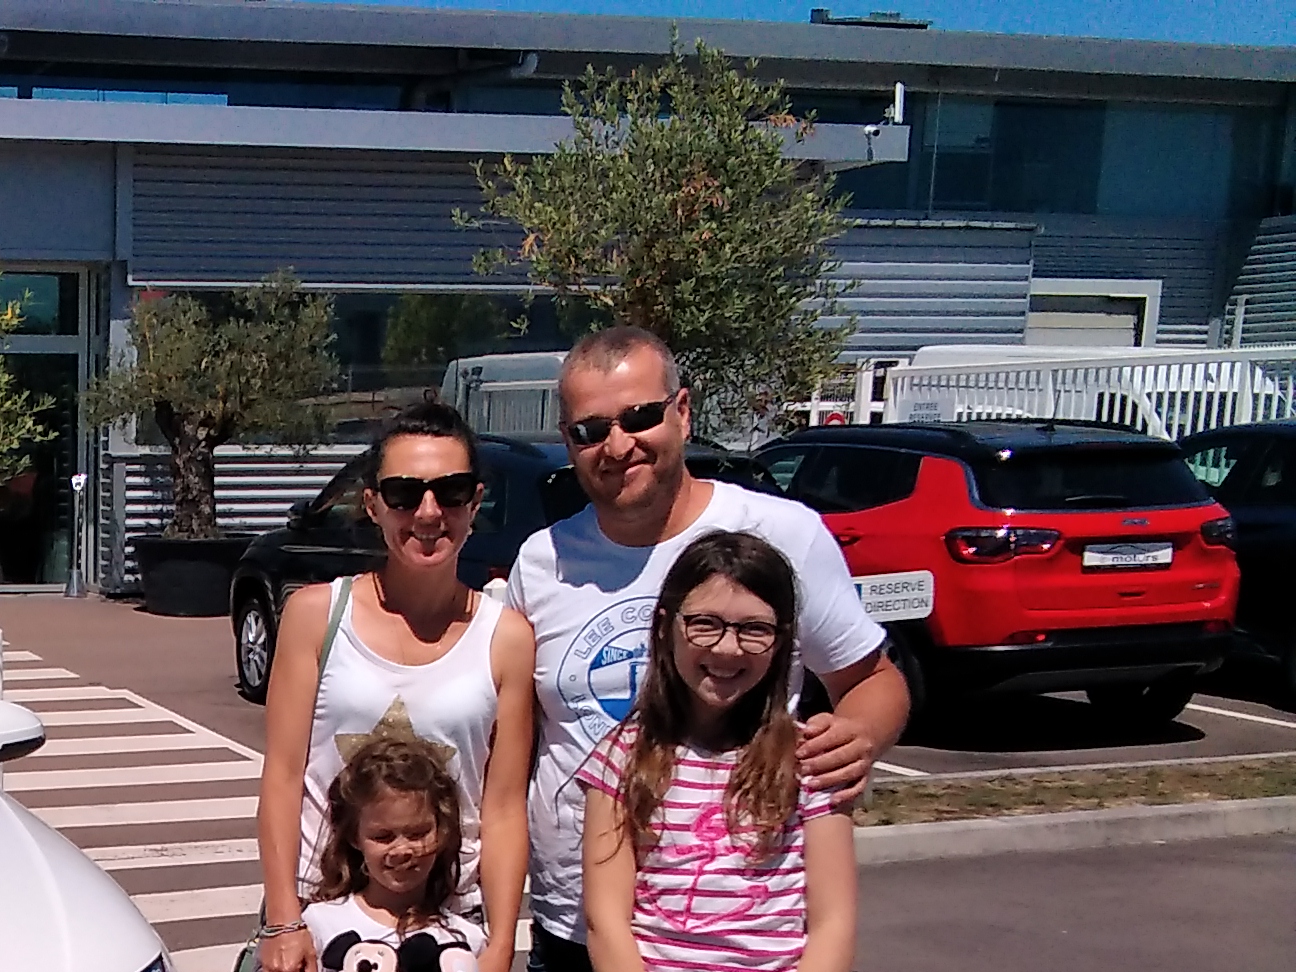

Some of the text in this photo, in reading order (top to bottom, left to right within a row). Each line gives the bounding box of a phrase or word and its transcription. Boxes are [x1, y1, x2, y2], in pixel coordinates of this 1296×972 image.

[869, 580, 925, 595] RESERVE
[864, 597, 929, 613] DIRECTION
[573, 617, 615, 660] LEE
[602, 646, 628, 665] SINCE
